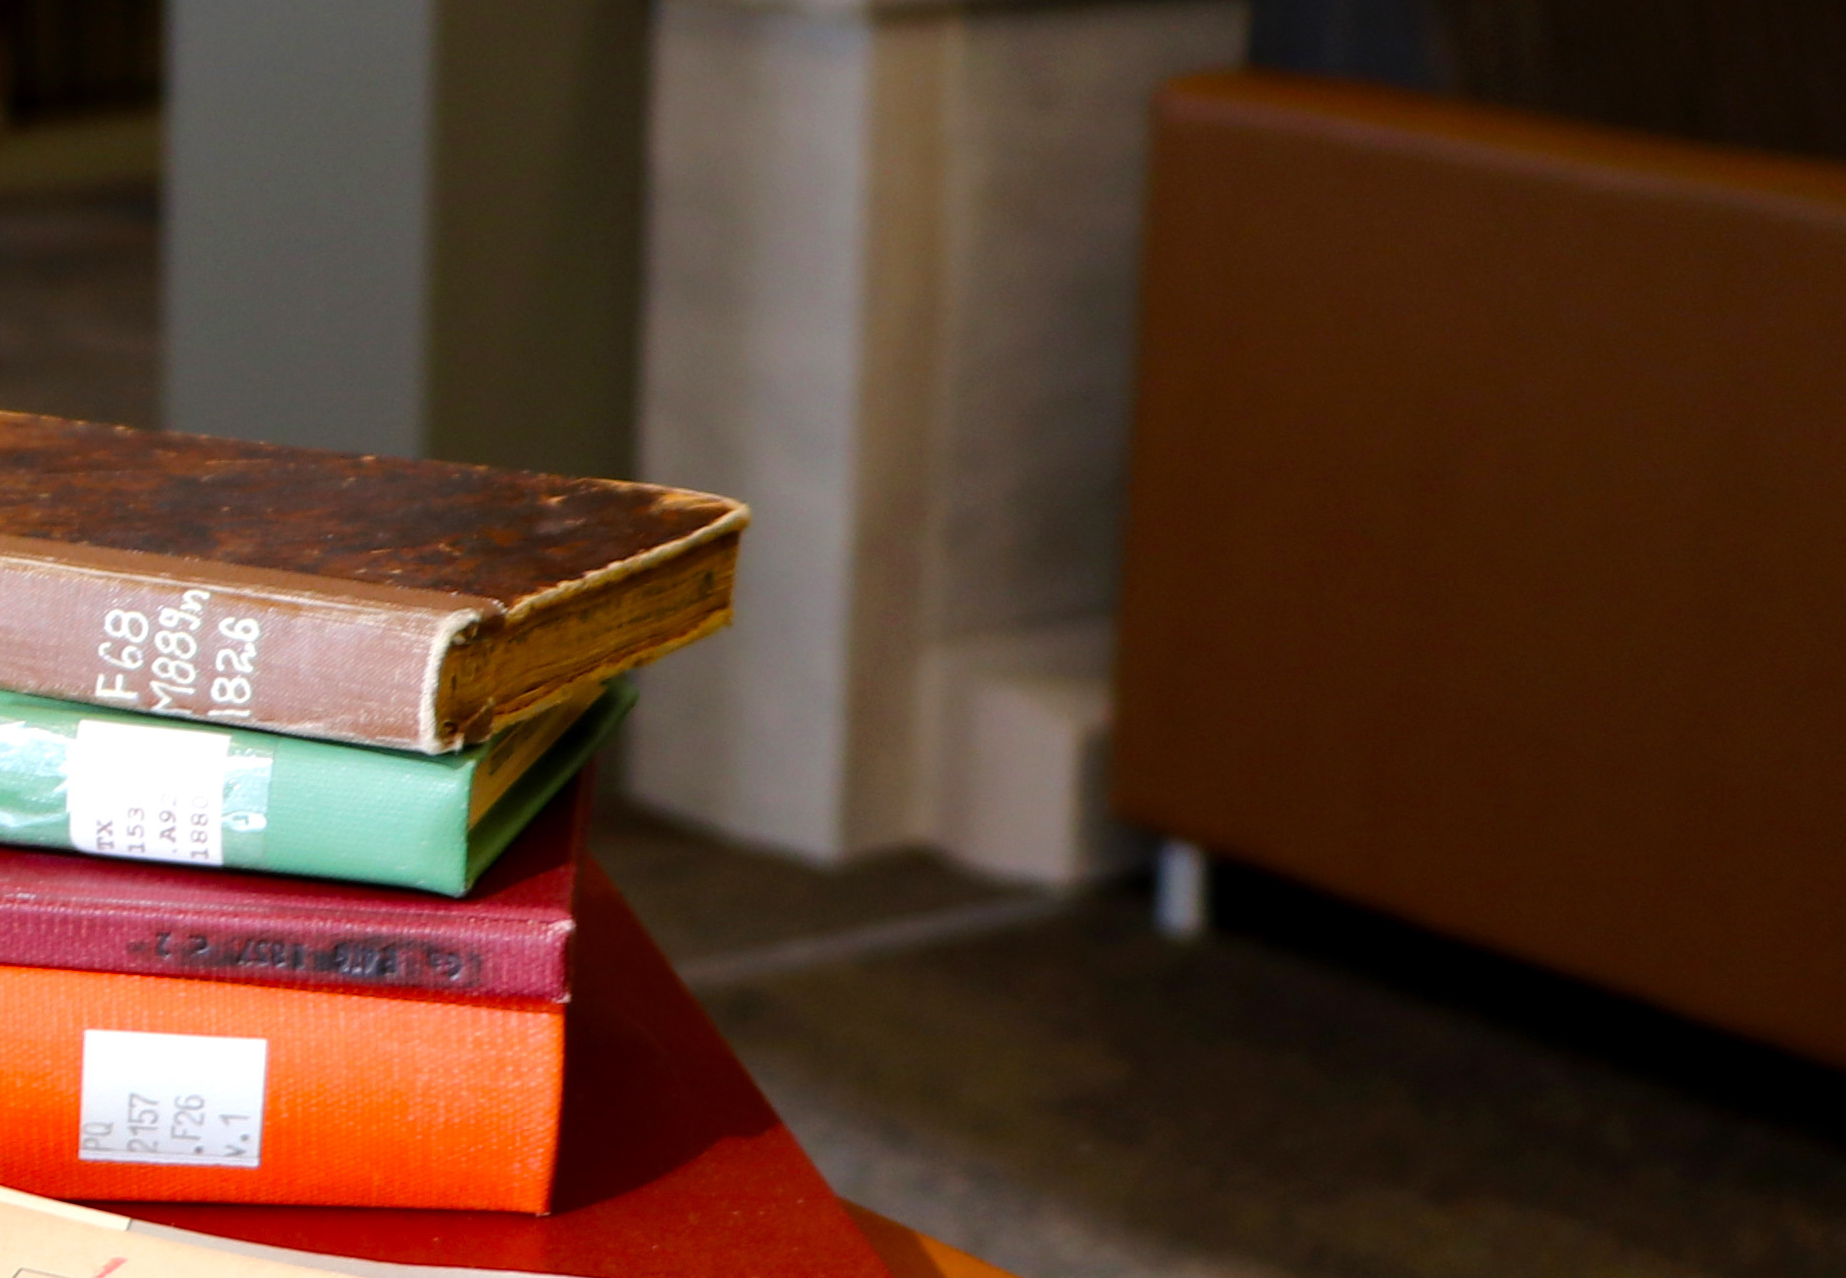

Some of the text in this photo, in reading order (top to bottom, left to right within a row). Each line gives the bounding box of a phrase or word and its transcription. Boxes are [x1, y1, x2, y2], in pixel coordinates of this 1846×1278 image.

[206, 616, 260, 717] 1826
[96, 819, 116, 854] TX
[126, 805, 149, 857] 153
[156, 932, 172, 960] 2
[81, 1118, 115, 1153] PQ
[128, 1092, 160, 1153] 2157
[171, 1092, 206, 1155] .F26
